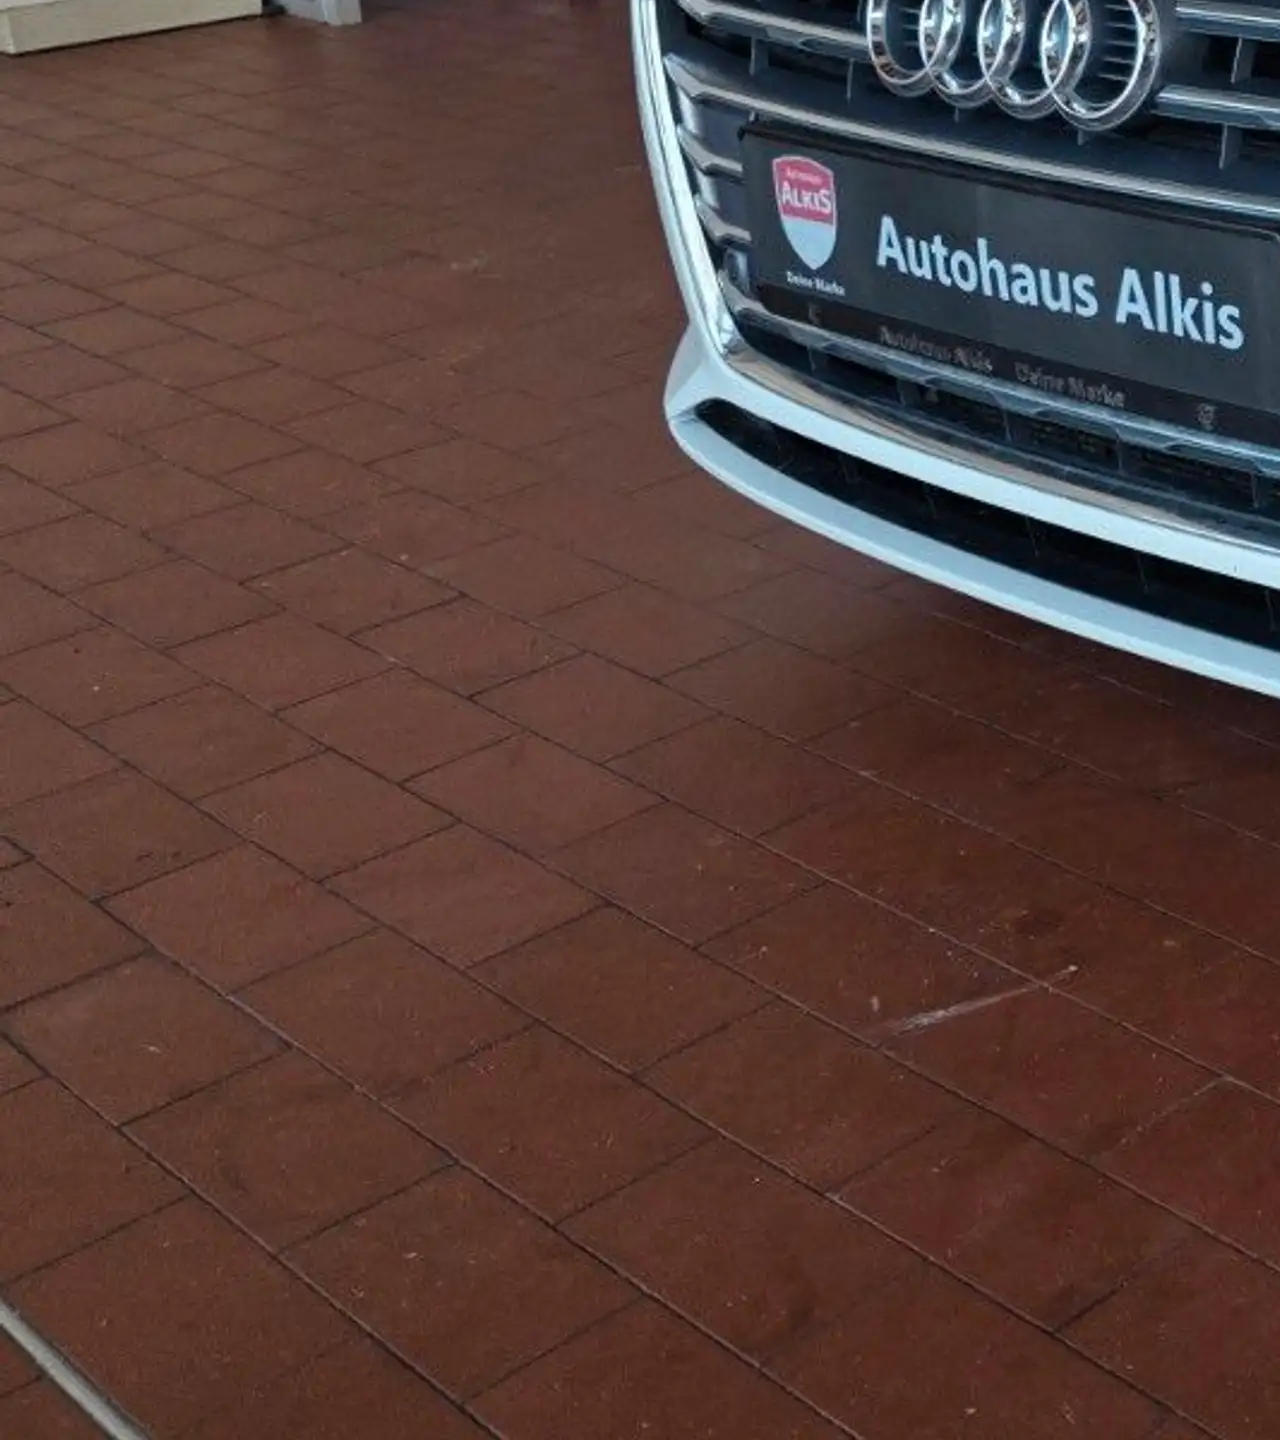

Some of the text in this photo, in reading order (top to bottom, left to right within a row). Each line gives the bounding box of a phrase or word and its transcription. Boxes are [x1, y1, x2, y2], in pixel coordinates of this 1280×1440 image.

[782, 181, 832, 213] ALKIS
[877, 215, 1244, 349] Autohaus Alkis
